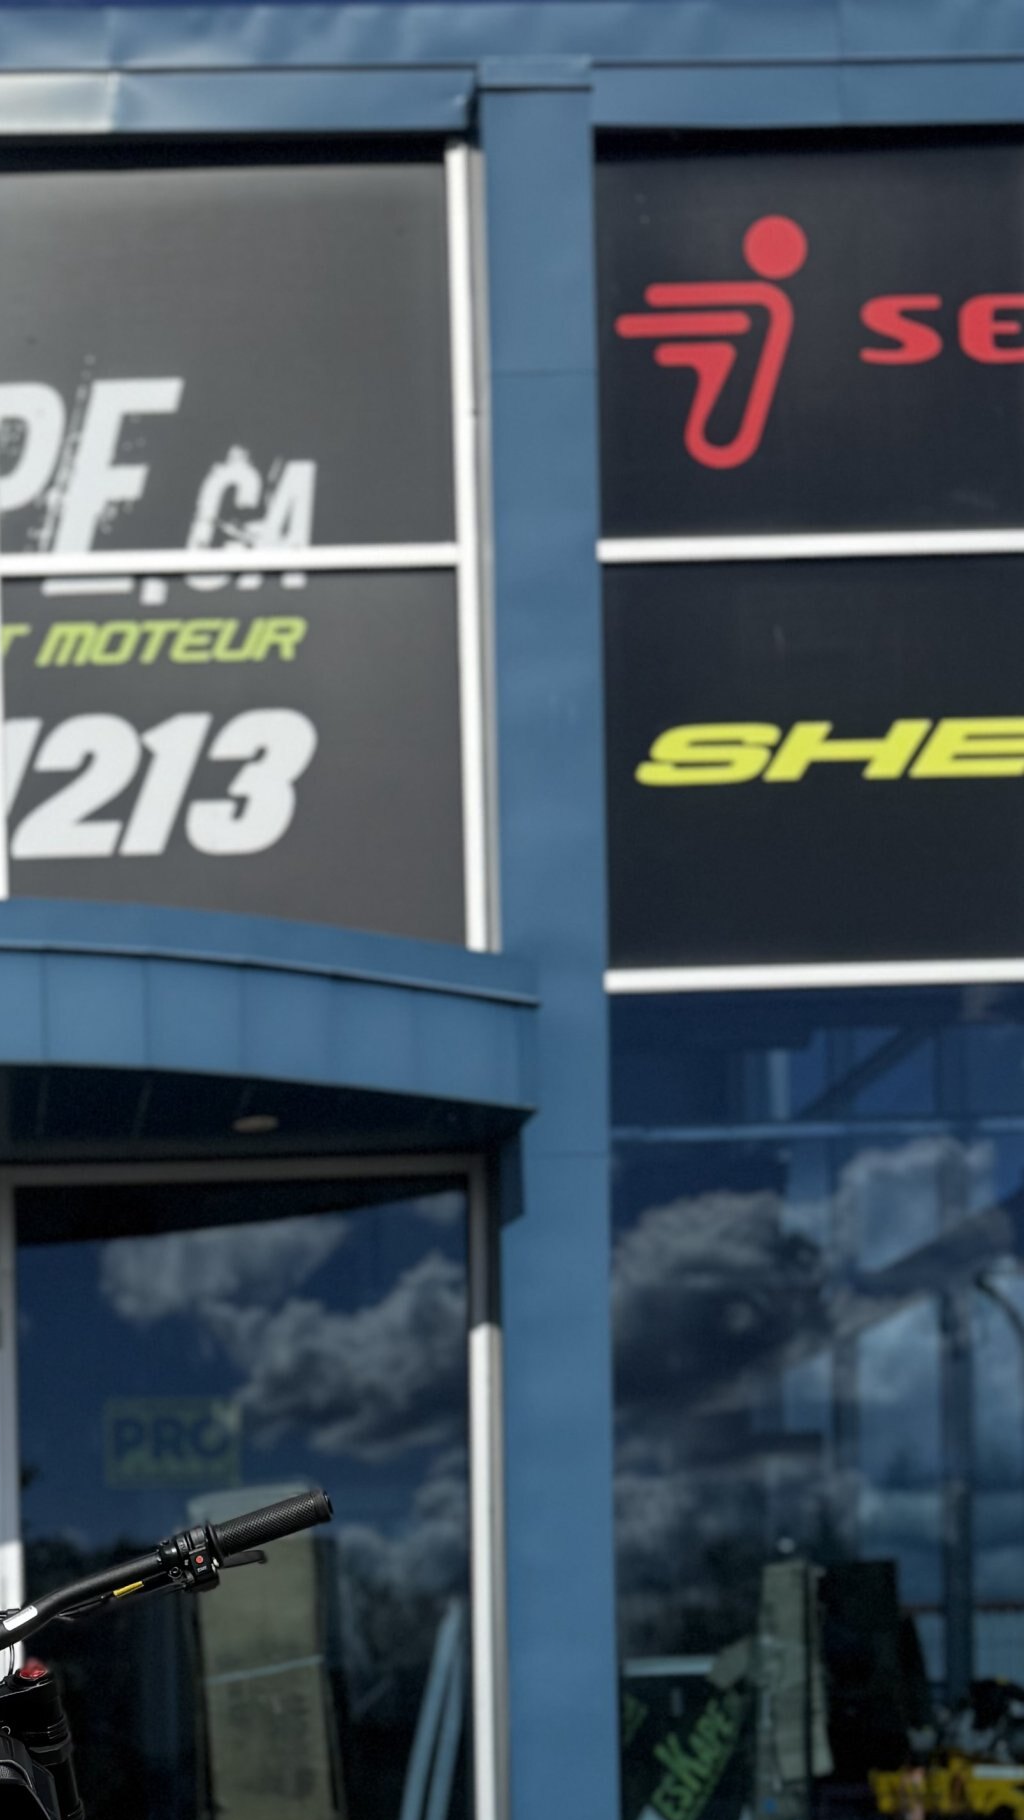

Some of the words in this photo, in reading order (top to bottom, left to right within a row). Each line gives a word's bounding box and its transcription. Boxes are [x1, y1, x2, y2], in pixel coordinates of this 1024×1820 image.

[860, 294, 1024, 364] SE
[35, 616, 307, 668] MOTEUR
[635, 718, 1024, 787] SHE
